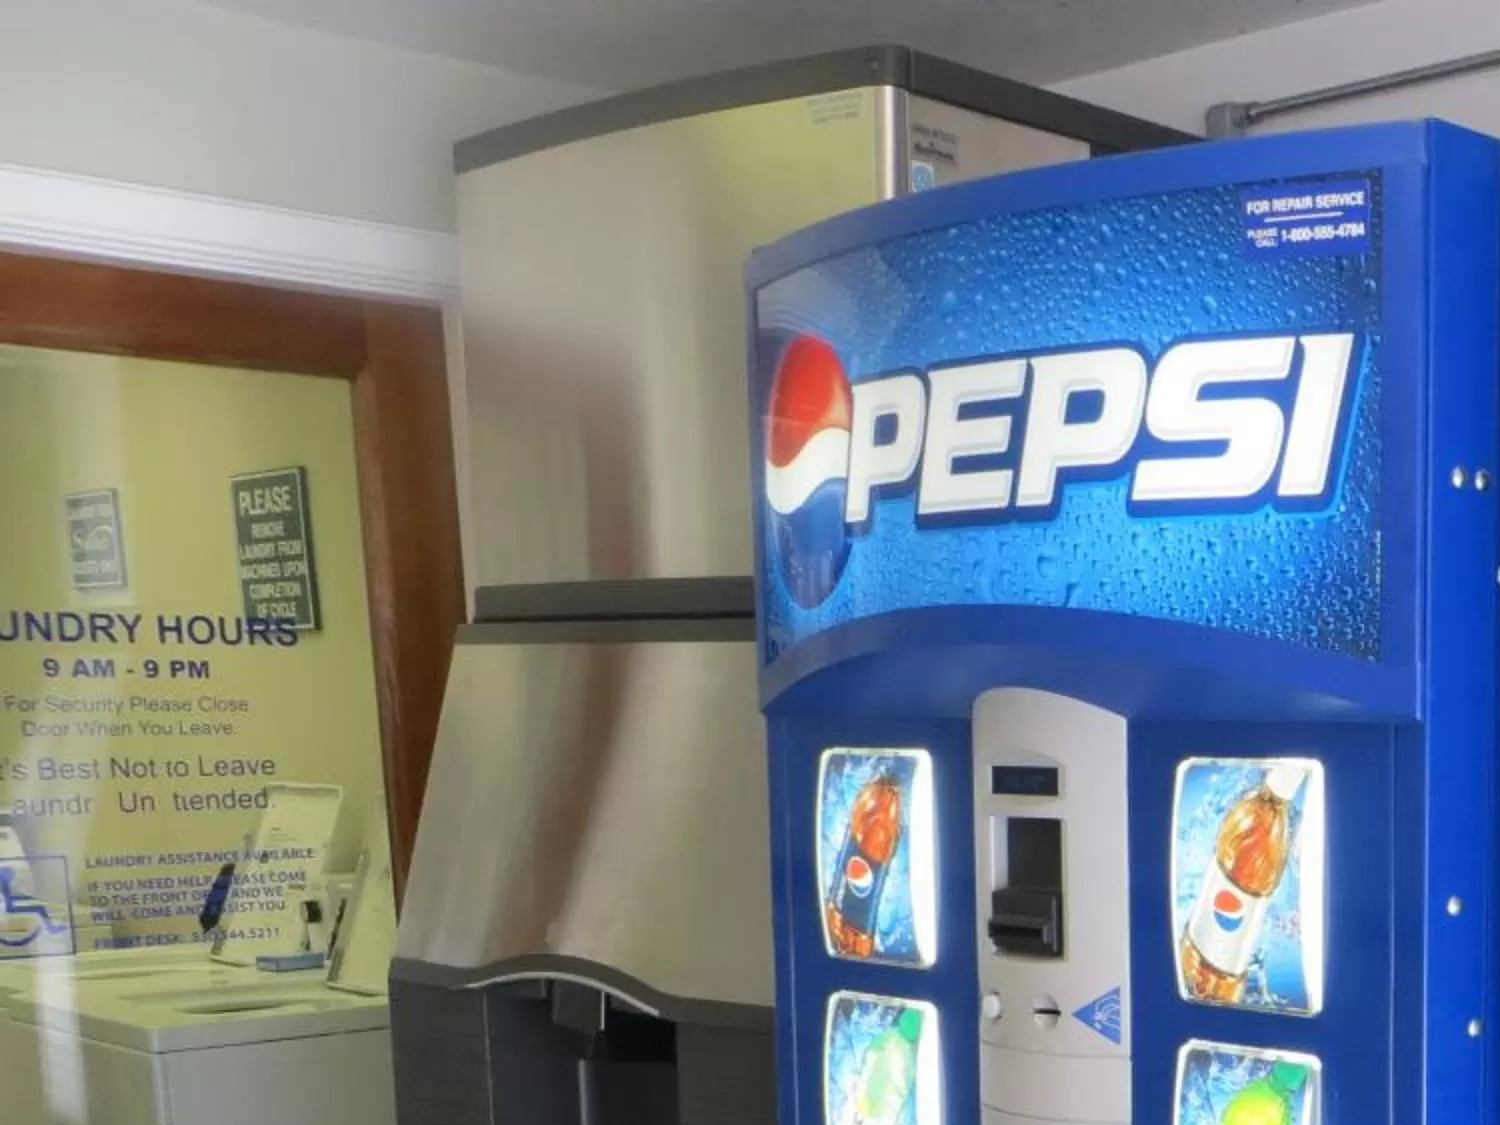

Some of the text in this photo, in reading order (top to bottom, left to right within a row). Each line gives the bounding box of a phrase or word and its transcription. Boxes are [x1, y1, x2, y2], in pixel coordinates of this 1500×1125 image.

[1315, 191, 1365, 209] SERVICE
[843, 331, 1357, 526] PEPSI
[238, 485, 294, 518] PLEASE
[157, 614, 299, 647] HOURS
[42, 658, 60, 678] 9
[71, 658, 116, 678] AM
[143, 659, 160, 679] 9
[169, 659, 210, 679] PM
[4, 695, 249, 715] For Security Please Close
[21, 720, 71, 737] Door
[75, 720, 133, 737] When
[138, 720, 174, 737] You
[37, 757, 100, 782] Best
[108, 757, 157, 779] Not
[161, 757, 190, 778] to
[198, 756, 277, 777] Leave
[157, 851, 236, 865] ASSISTANCE
[104, 880, 134, 892] YOU
[136, 878, 174, 890] NEED
[269, 871, 308, 883] COME
[143, 891, 191, 904] FRONT
[263, 886, 284, 897] WE
[258, 900, 286, 912] YOU
